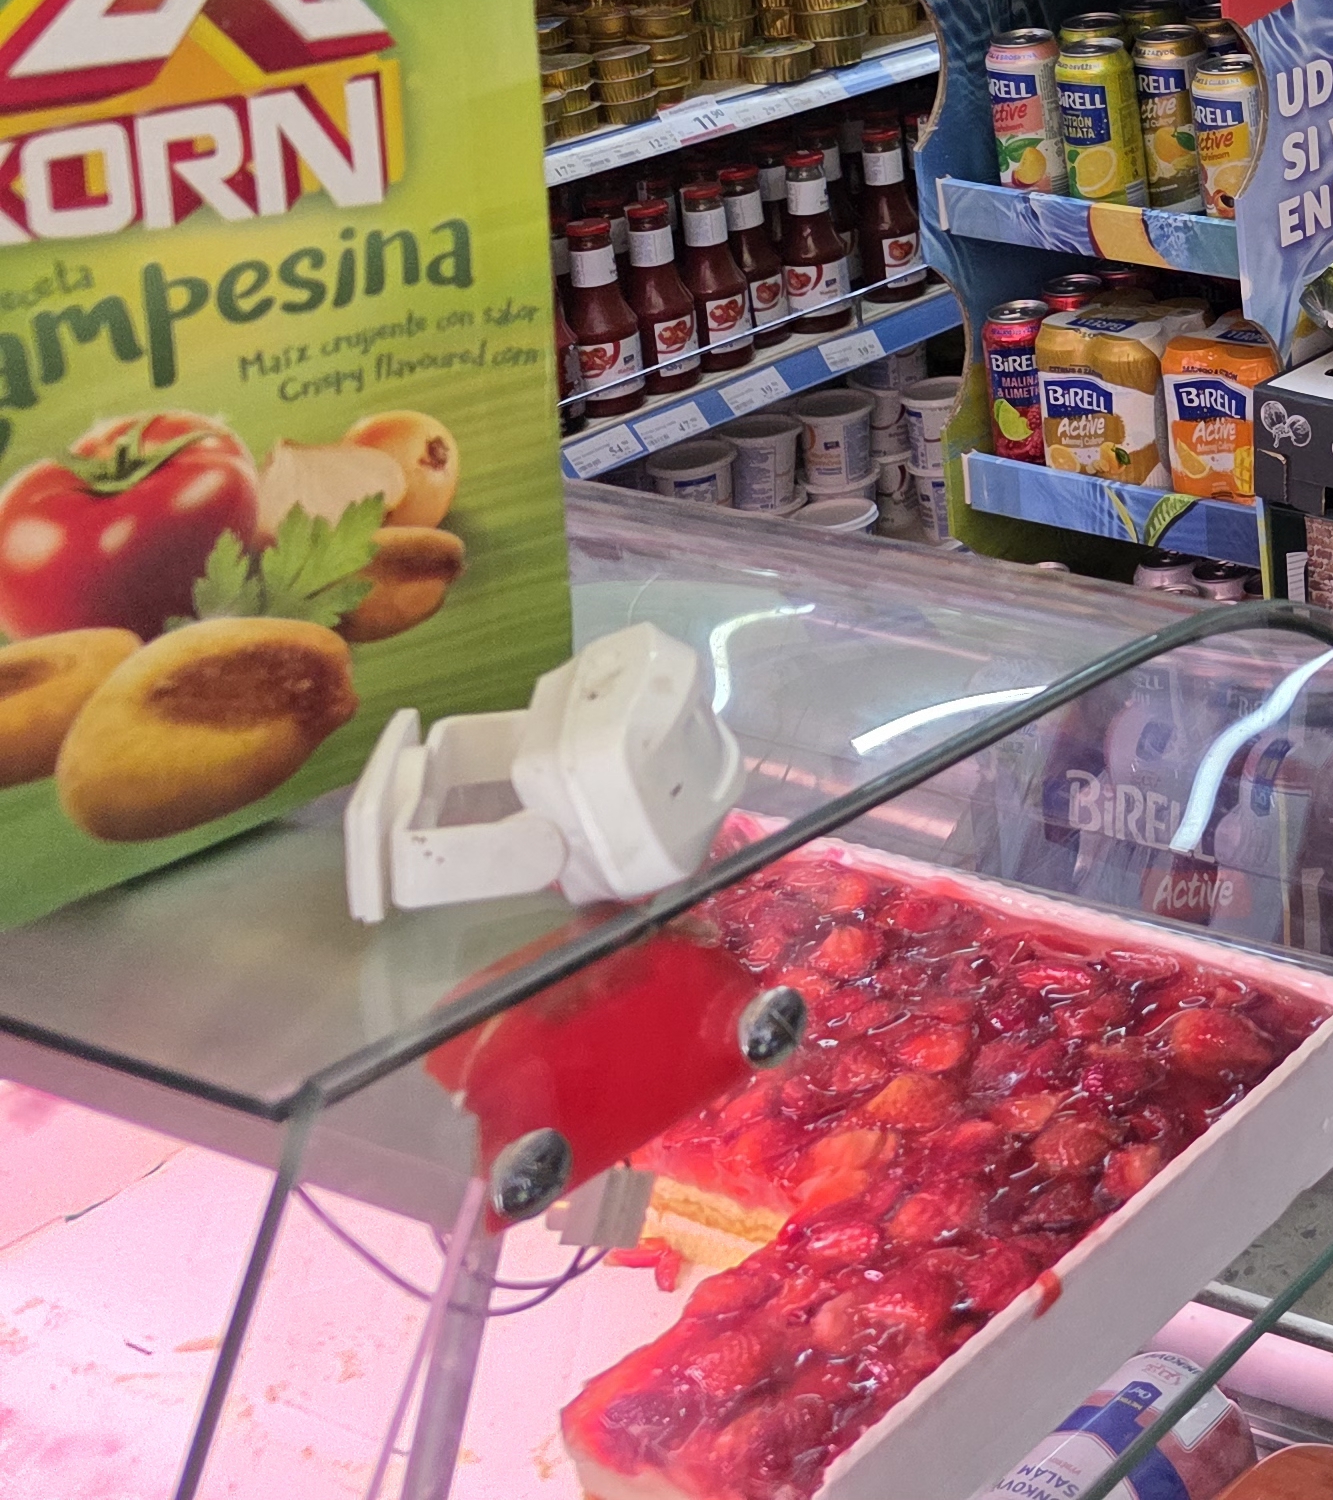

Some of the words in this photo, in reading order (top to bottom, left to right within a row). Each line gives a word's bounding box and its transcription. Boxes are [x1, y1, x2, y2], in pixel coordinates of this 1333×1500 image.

[693, 114, 713, 131] 11
[712, 108, 724, 120] 90
[1283, 128, 1321, 181] SI
[277, 362, 364, 401] Crispy
[375, 340, 485, 382] flavoured
[1047, 386, 1108, 414] BiRELL
[1178, 387, 1241, 419] BiRELL
[1057, 414, 1105, 437] Active
[1192, 418, 1237, 443] Active
[1153, 873, 1234, 910] Active
